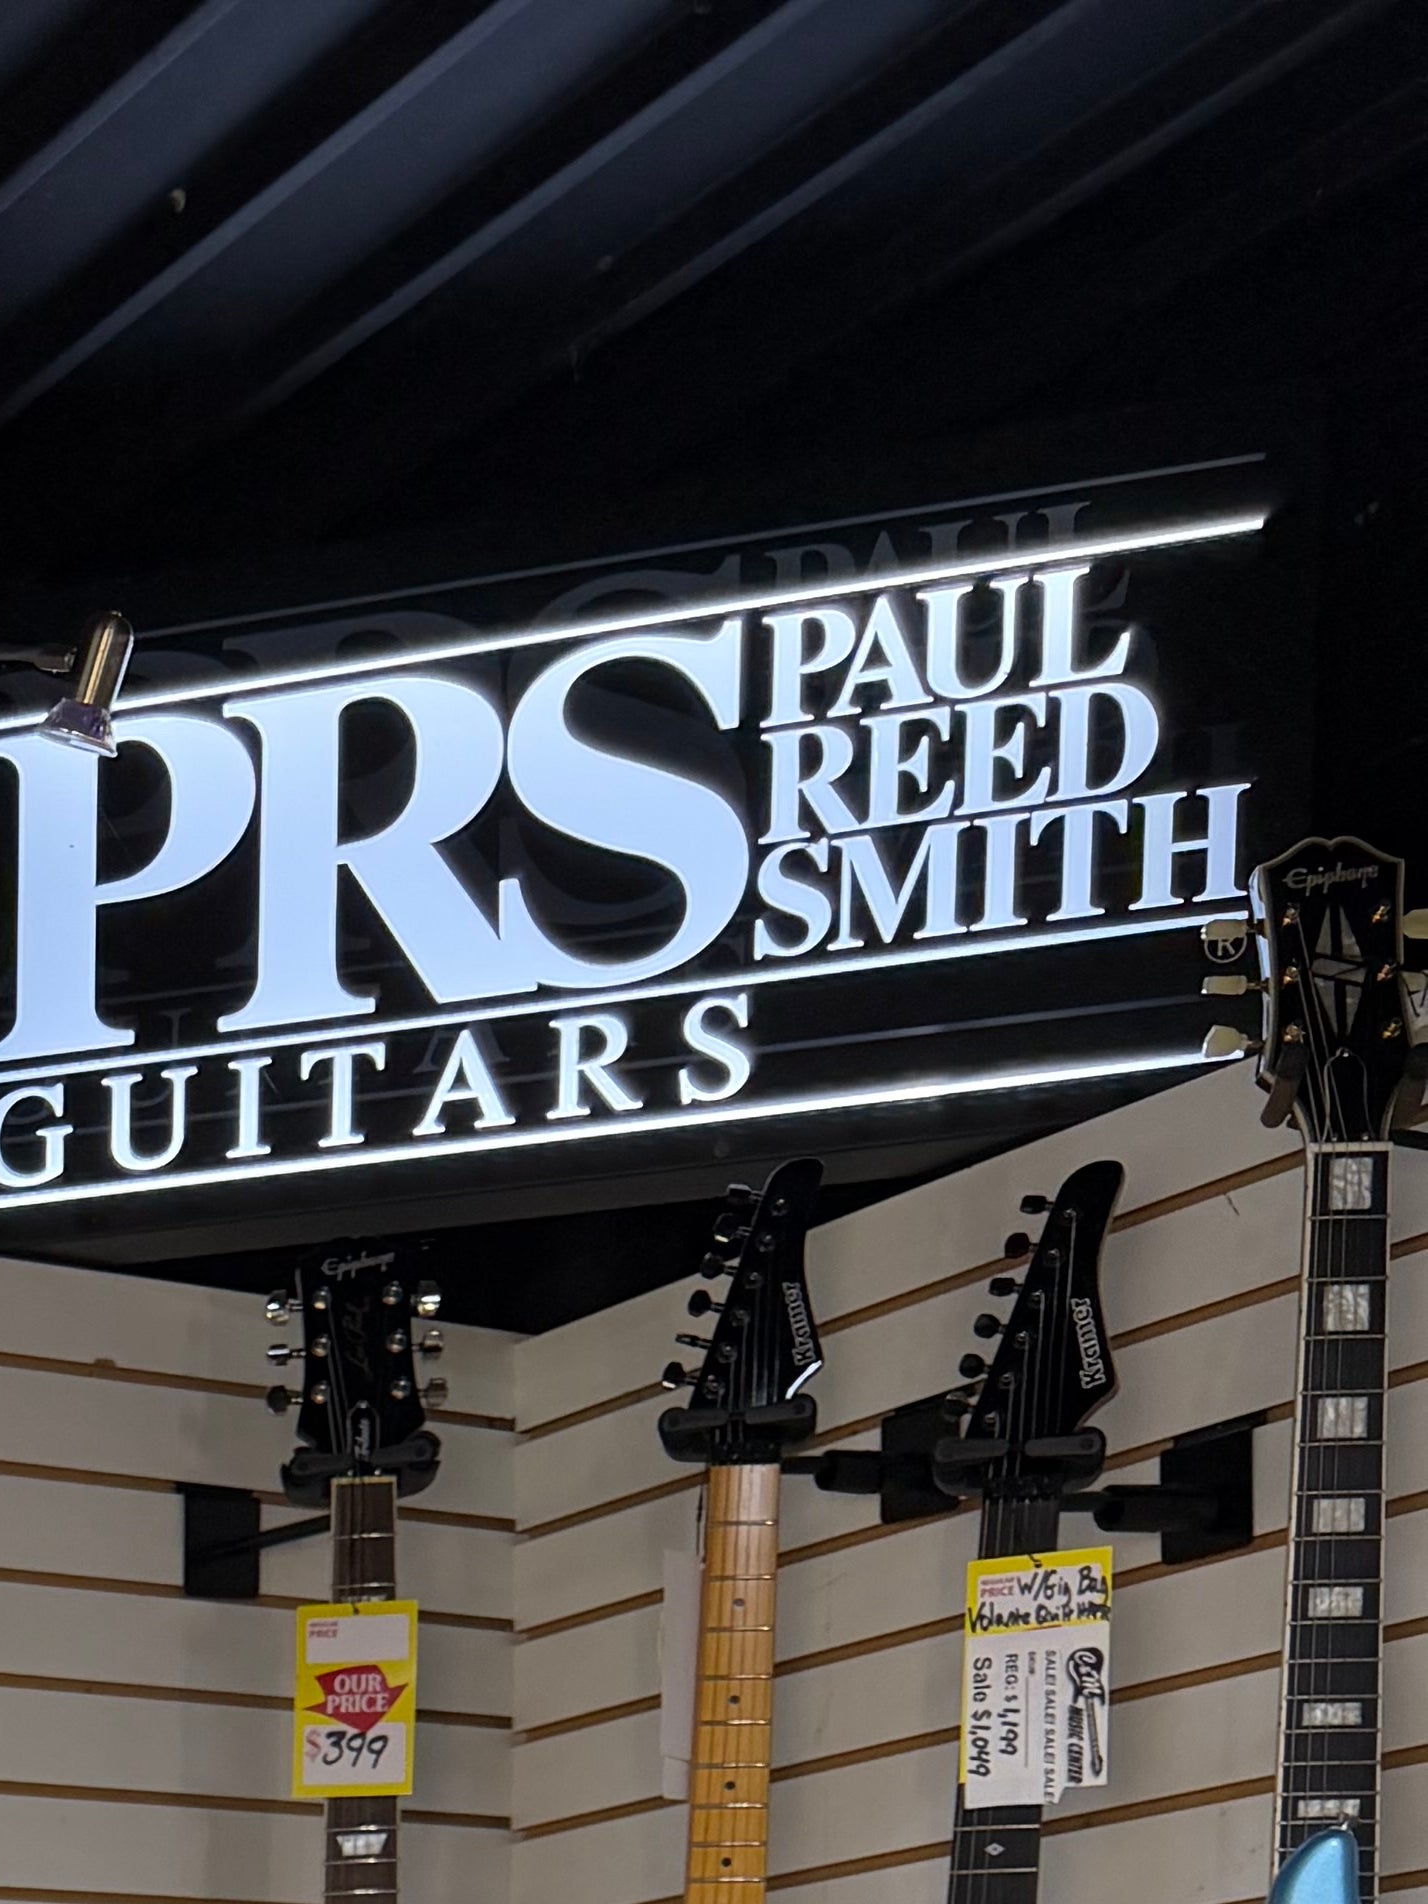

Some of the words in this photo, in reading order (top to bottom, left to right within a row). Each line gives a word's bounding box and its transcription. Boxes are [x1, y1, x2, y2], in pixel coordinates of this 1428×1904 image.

[761, 566, 1130, 728] PAUL
[758, 682, 1160, 846] REED
[753, 782, 1251, 962] SMITH
[1282, 861, 1379, 897] Epiphone
[782, 1282, 815, 1366] Kramer
[1071, 1298, 1106, 1389] Kramer
[333, 1673, 382, 1694] OUR
[972, 1656, 992, 1703] Sale
[326, 1693, 390, 1714] PRICE
[1067, 1704, 1084, 1740] MUSIC
[306, 1730, 389, 1769] $399
[1066, 1742, 1084, 1784] CENTER
